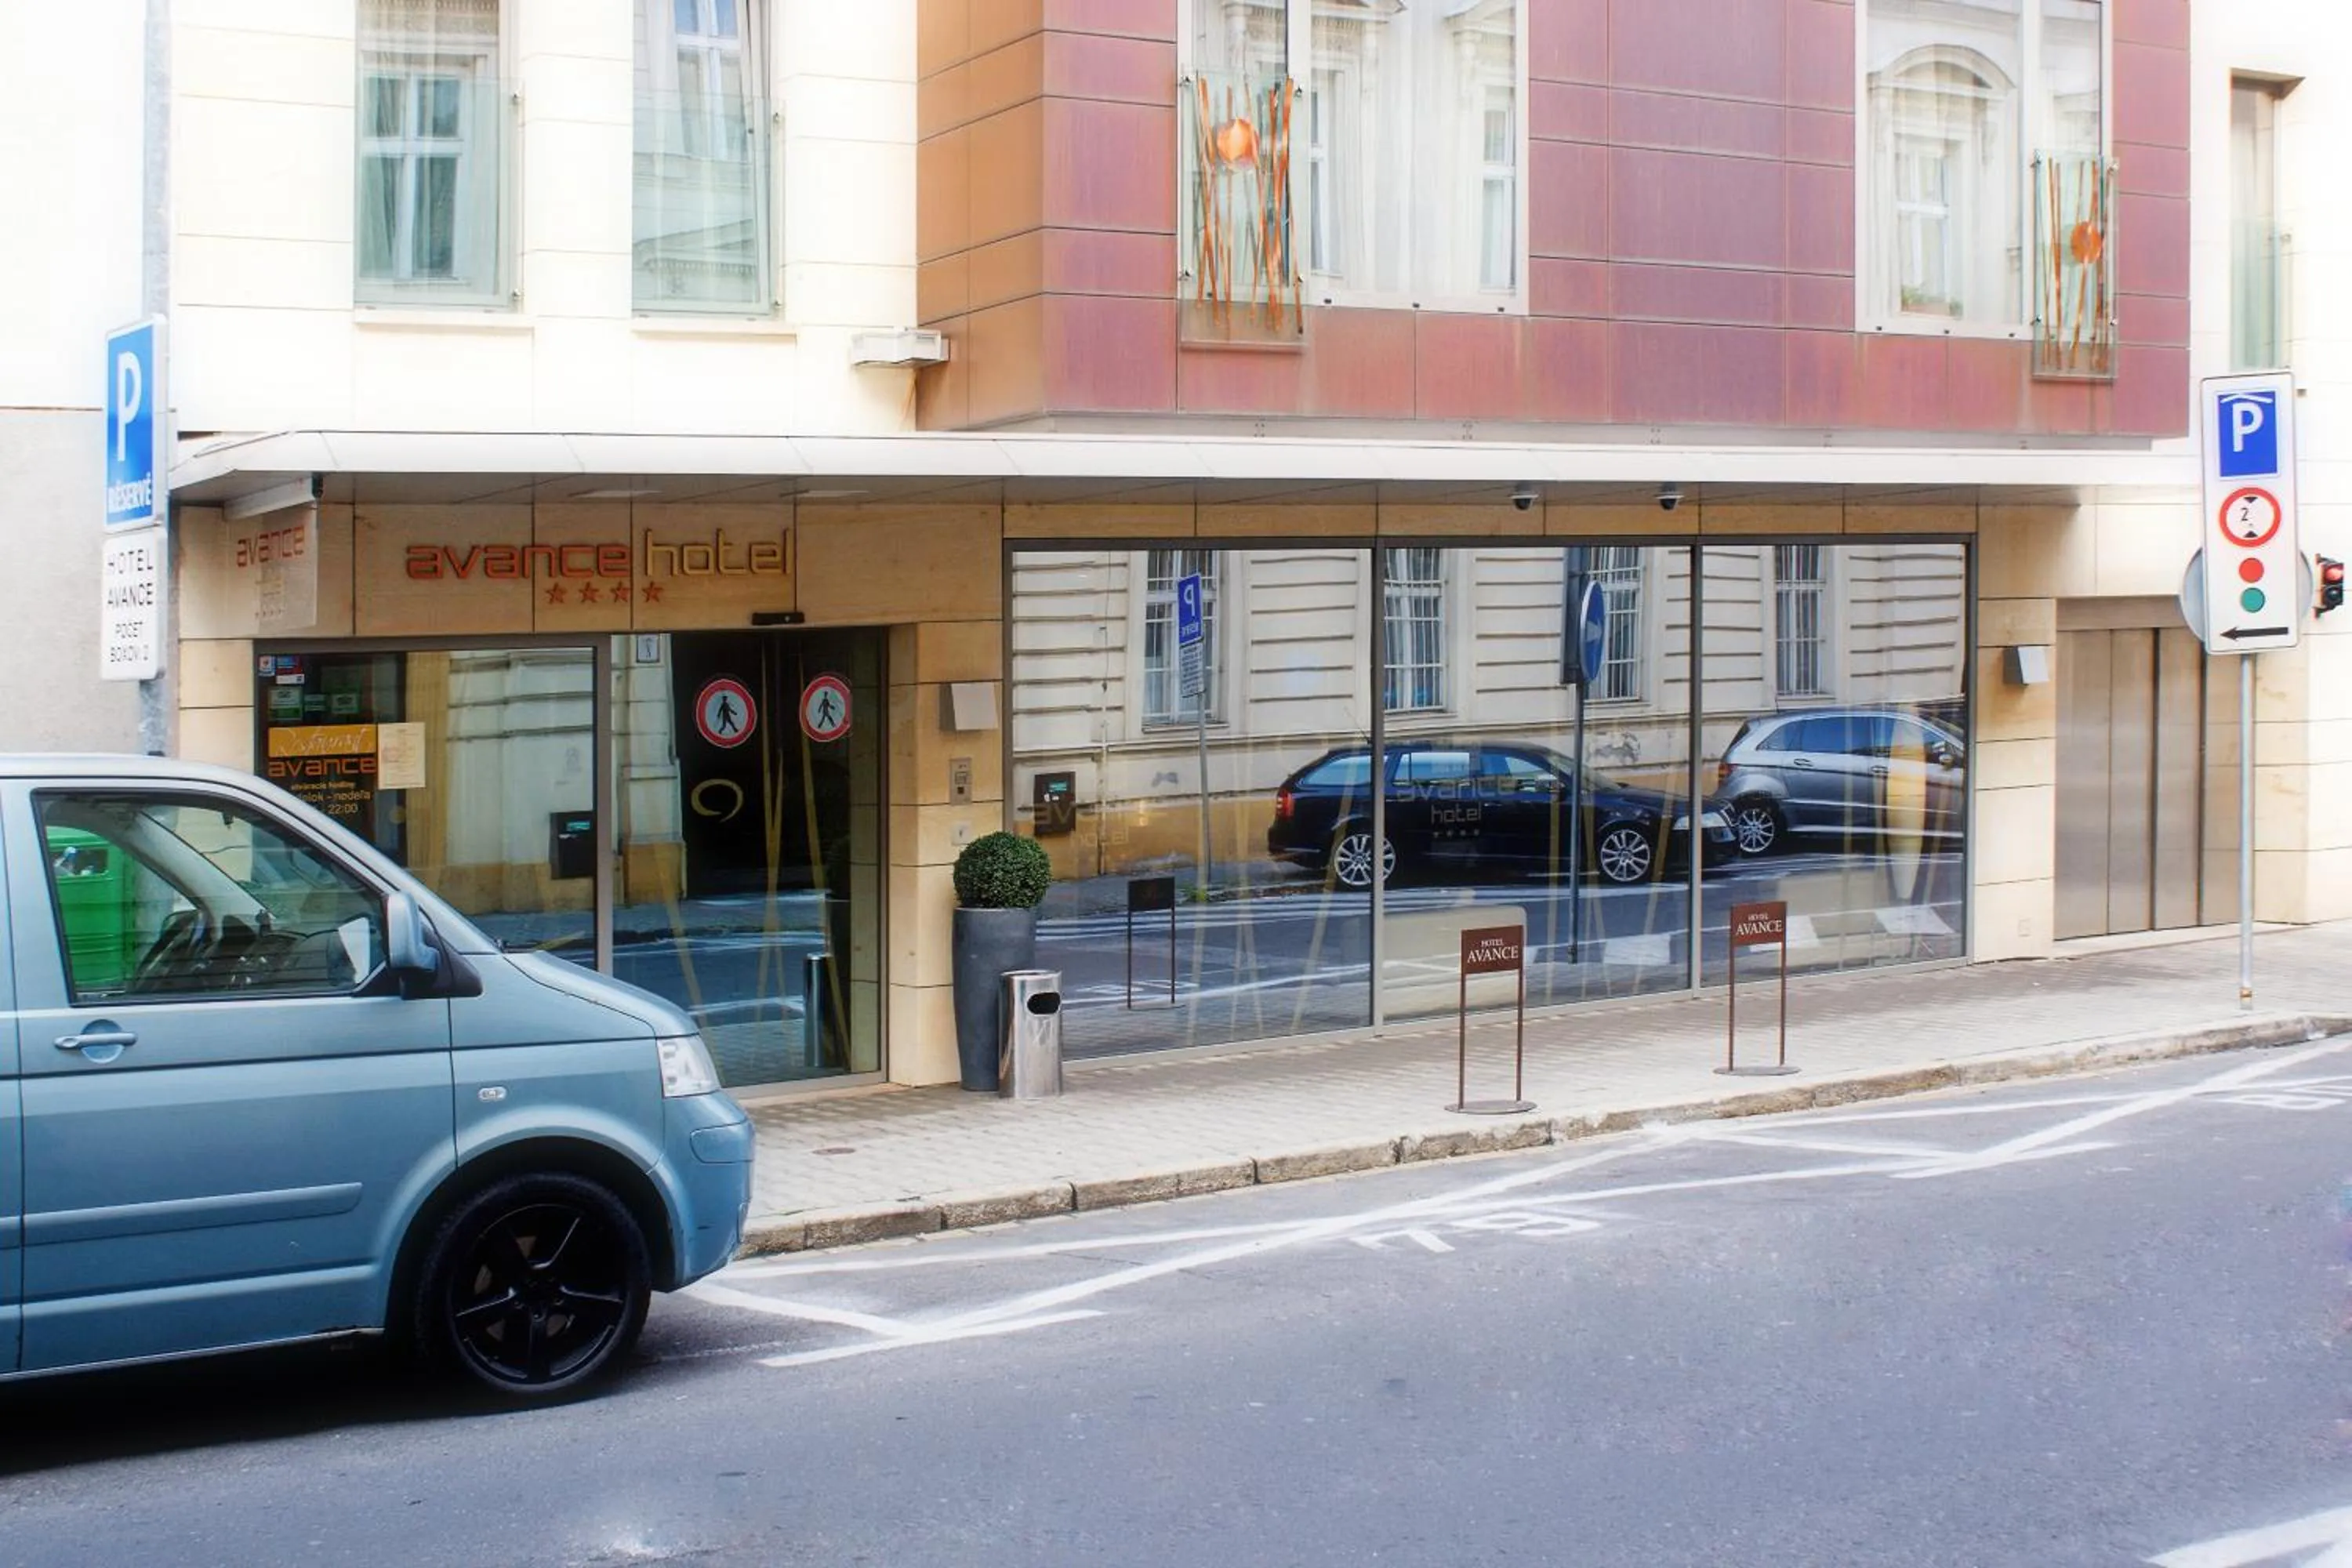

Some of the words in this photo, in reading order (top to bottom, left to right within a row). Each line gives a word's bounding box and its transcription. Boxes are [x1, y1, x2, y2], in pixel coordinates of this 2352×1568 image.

[117, 350, 142, 462] P
[2233, 402, 2264, 452] P
[237, 525, 304, 568] avance
[406, 541, 630, 579] avance
[644, 528, 790, 577] hotel
[108, 549, 154, 574] HOTEL
[107, 582, 153, 608] AVANCE
[268, 757, 377, 777] avance
[1431, 801, 1482, 824] hotel
[1736, 920, 1782, 936] AVANCE
[1467, 945, 1519, 964] AVANCE
